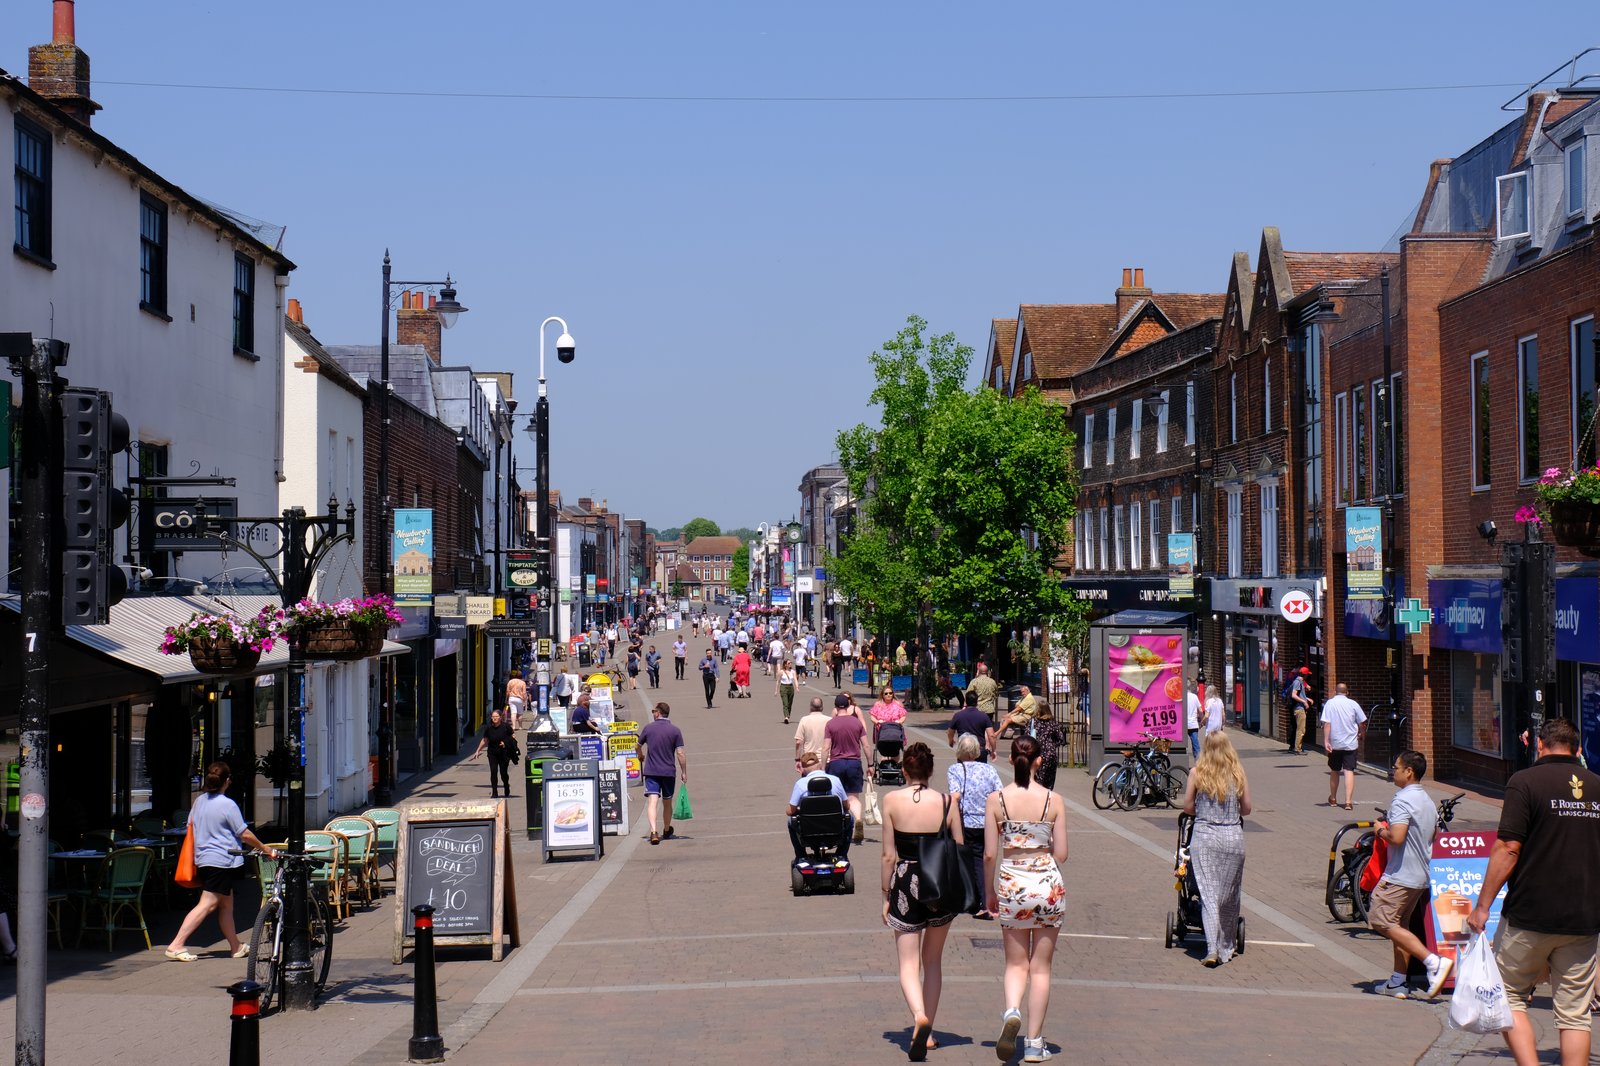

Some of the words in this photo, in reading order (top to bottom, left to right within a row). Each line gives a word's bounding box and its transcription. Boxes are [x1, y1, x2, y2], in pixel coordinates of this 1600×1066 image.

[155, 510, 221, 528] CÔE
[235, 524, 269, 541] ASSERIE
[1448, 600, 1486, 629] pharmacy
[1554, 604, 1580, 635] eauty
[26, 633, 37, 652] 7
[1535, 690, 1542, 701] 6
[1142, 710, 1177, 728] £1.99
[552, 761, 589, 772] CÔTE
[557, 788, 585, 797] 16.95
[410, 807, 430, 815] LOCK
[431, 806, 457, 814] STOCK
[1550, 800, 1558, 809] E
[423, 838, 480, 854] SANDWICH
[1439, 836, 1485, 849] COSTA
[435, 858, 463, 873] DEAL
[1447, 872, 1459, 881] of
[1461, 871, 1482, 881] the
